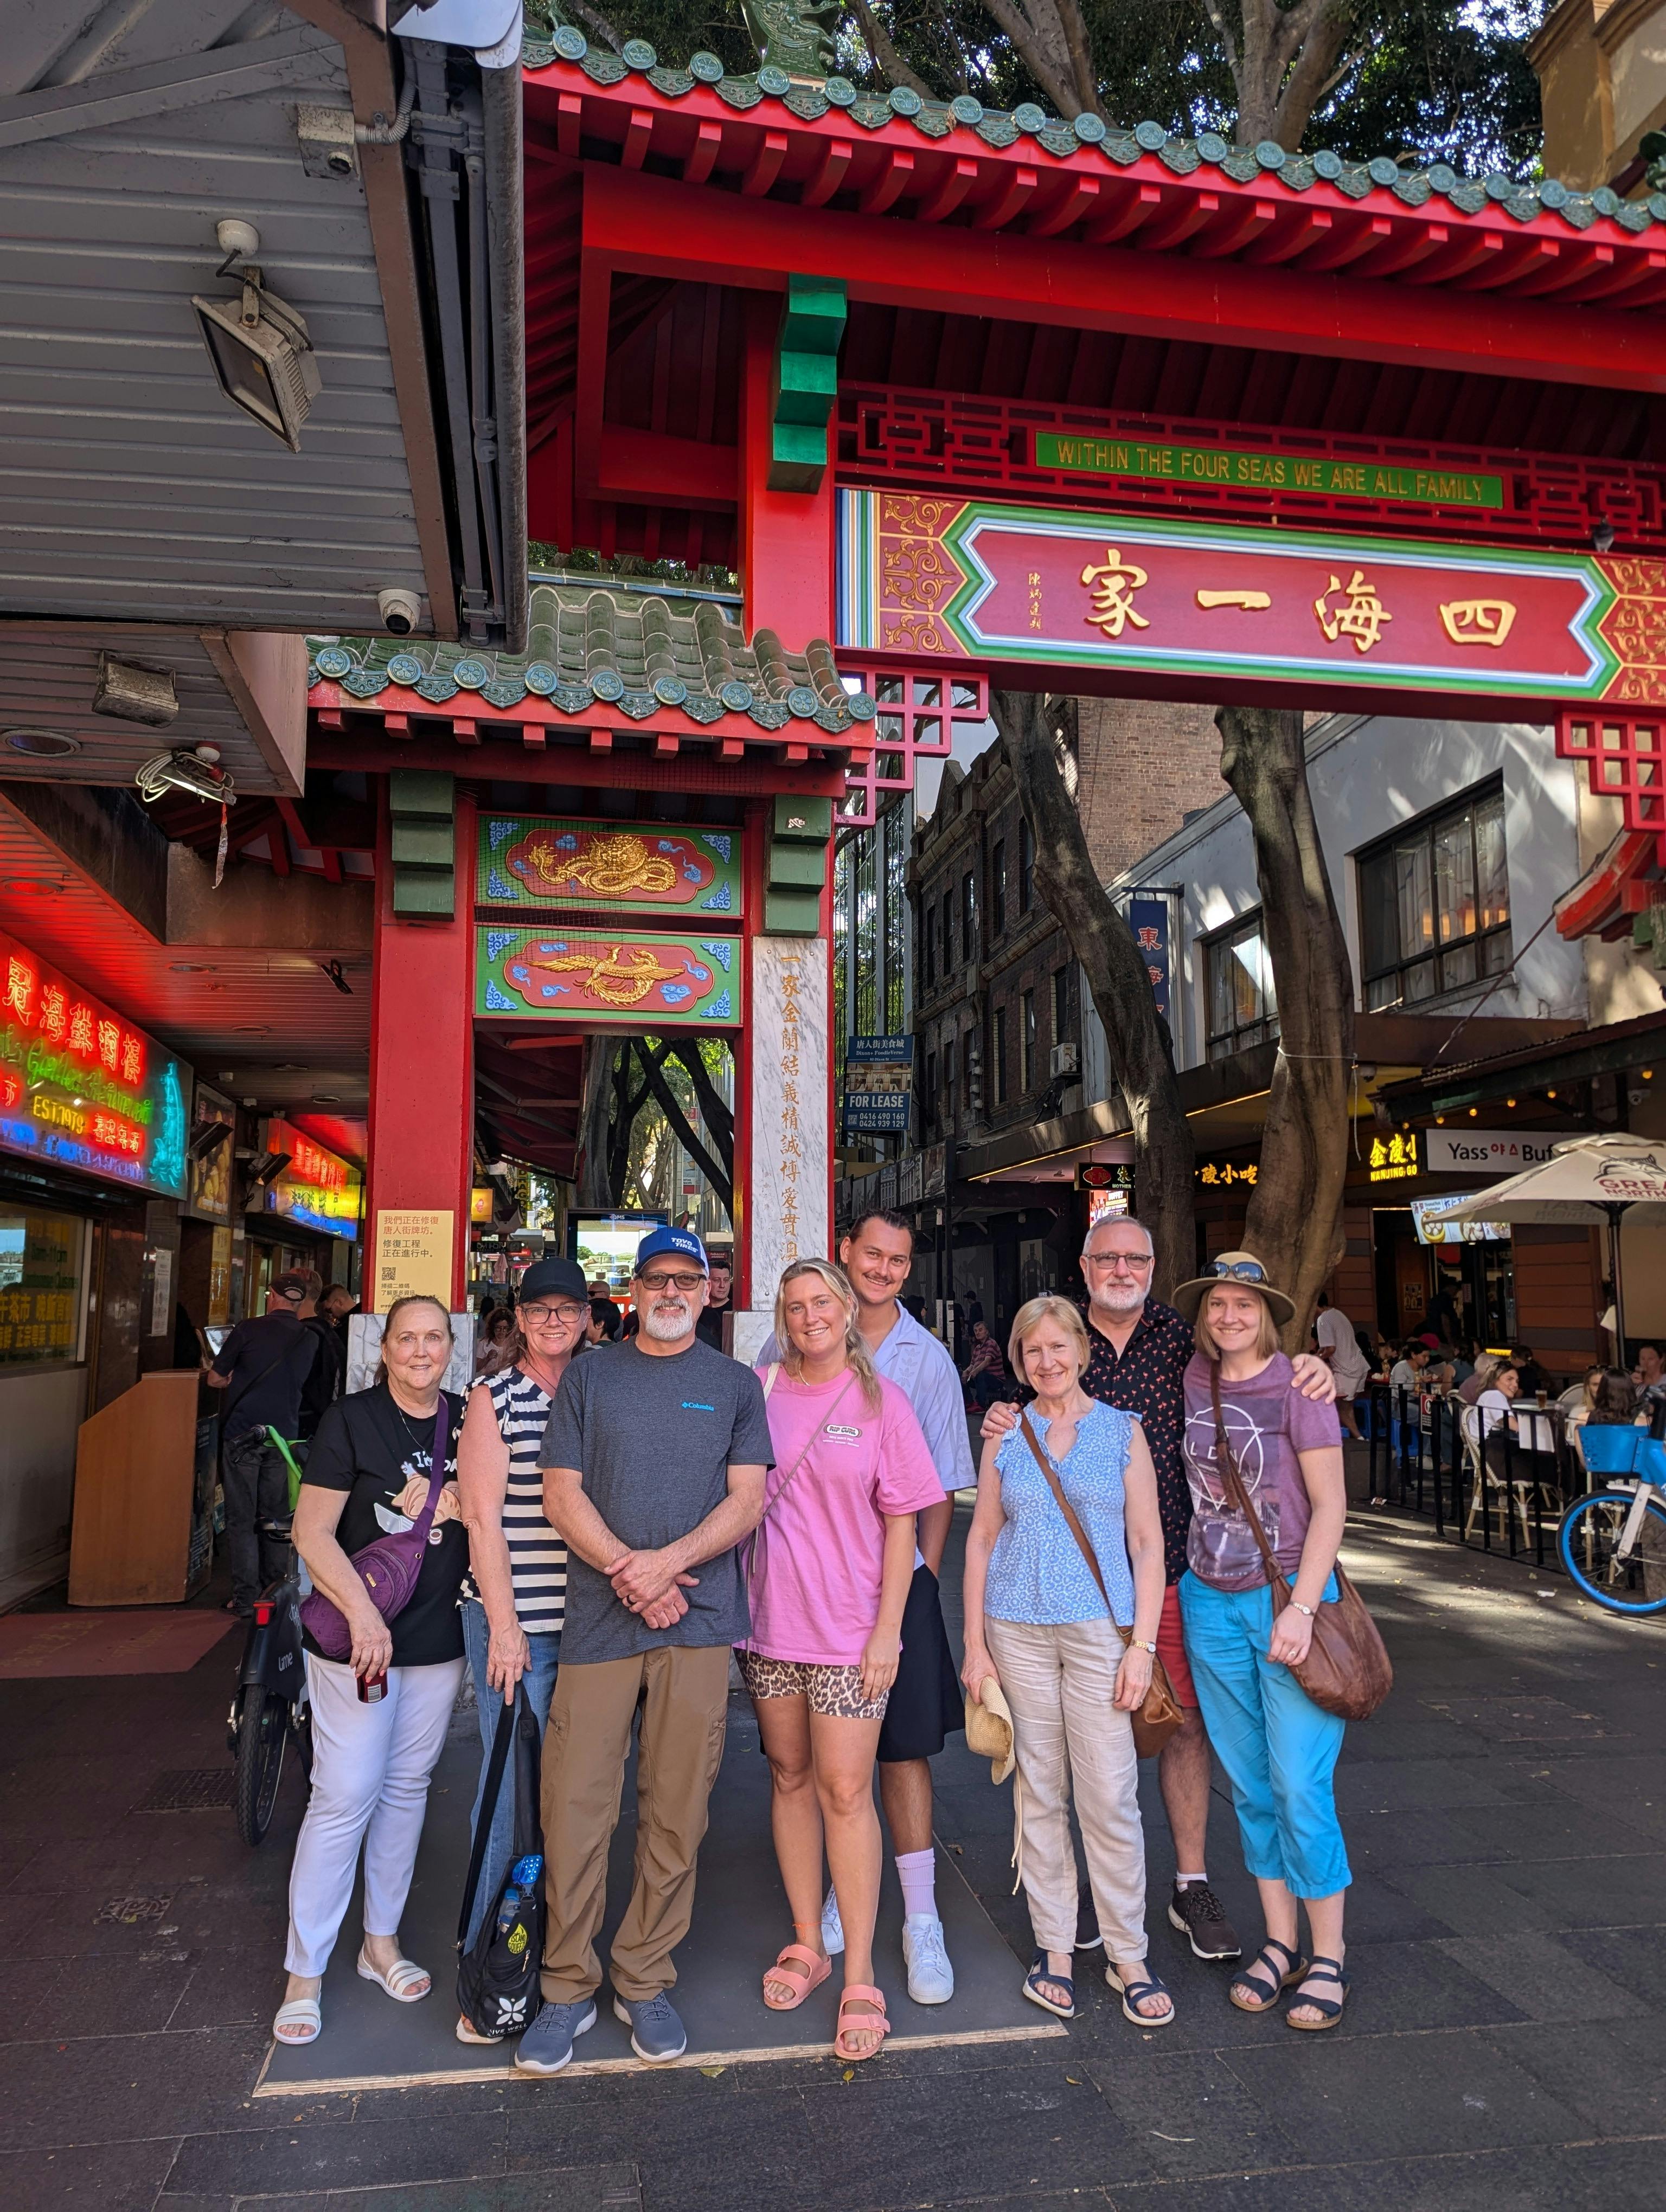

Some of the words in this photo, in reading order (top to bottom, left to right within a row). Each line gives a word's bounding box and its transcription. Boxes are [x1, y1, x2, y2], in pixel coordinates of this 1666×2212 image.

[1058, 441, 1128, 469] WITHIN
[1137, 448, 1173, 473] THE
[1181, 452, 1230, 479] FOUR
[1238, 458, 1286, 484] SEAS
[1293, 463, 1322, 487] WE
[1330, 467, 1367, 491] ARE
[1374, 471, 1408, 494] ALL
[1416, 474, 1483, 501] FAMILY
[856, 1039, 905, 1050] 唐人街美食城
[849, 1095, 869, 1108] FOR
[872, 1095, 904, 1108] LEASE
[1448, 1143, 1488, 1160] Yass
[1195, 1163, 1258, 1184] 陵小吃
[1370, 1167, 1405, 1182] NANJING
[1598, 1179, 1666, 1190] GRE
[383, 1216, 439, 1225] 我們正在修復
[383, 1239, 420, 1248] 修復工程
[675, 1243, 699, 1253] TIRES
[382, 1249, 433, 1258] 正在進行中。
[688, 1402, 714, 1411] Columbia
[841, 1427, 856, 1435] CURL
[508, 2023, 527, 2031] WELL
